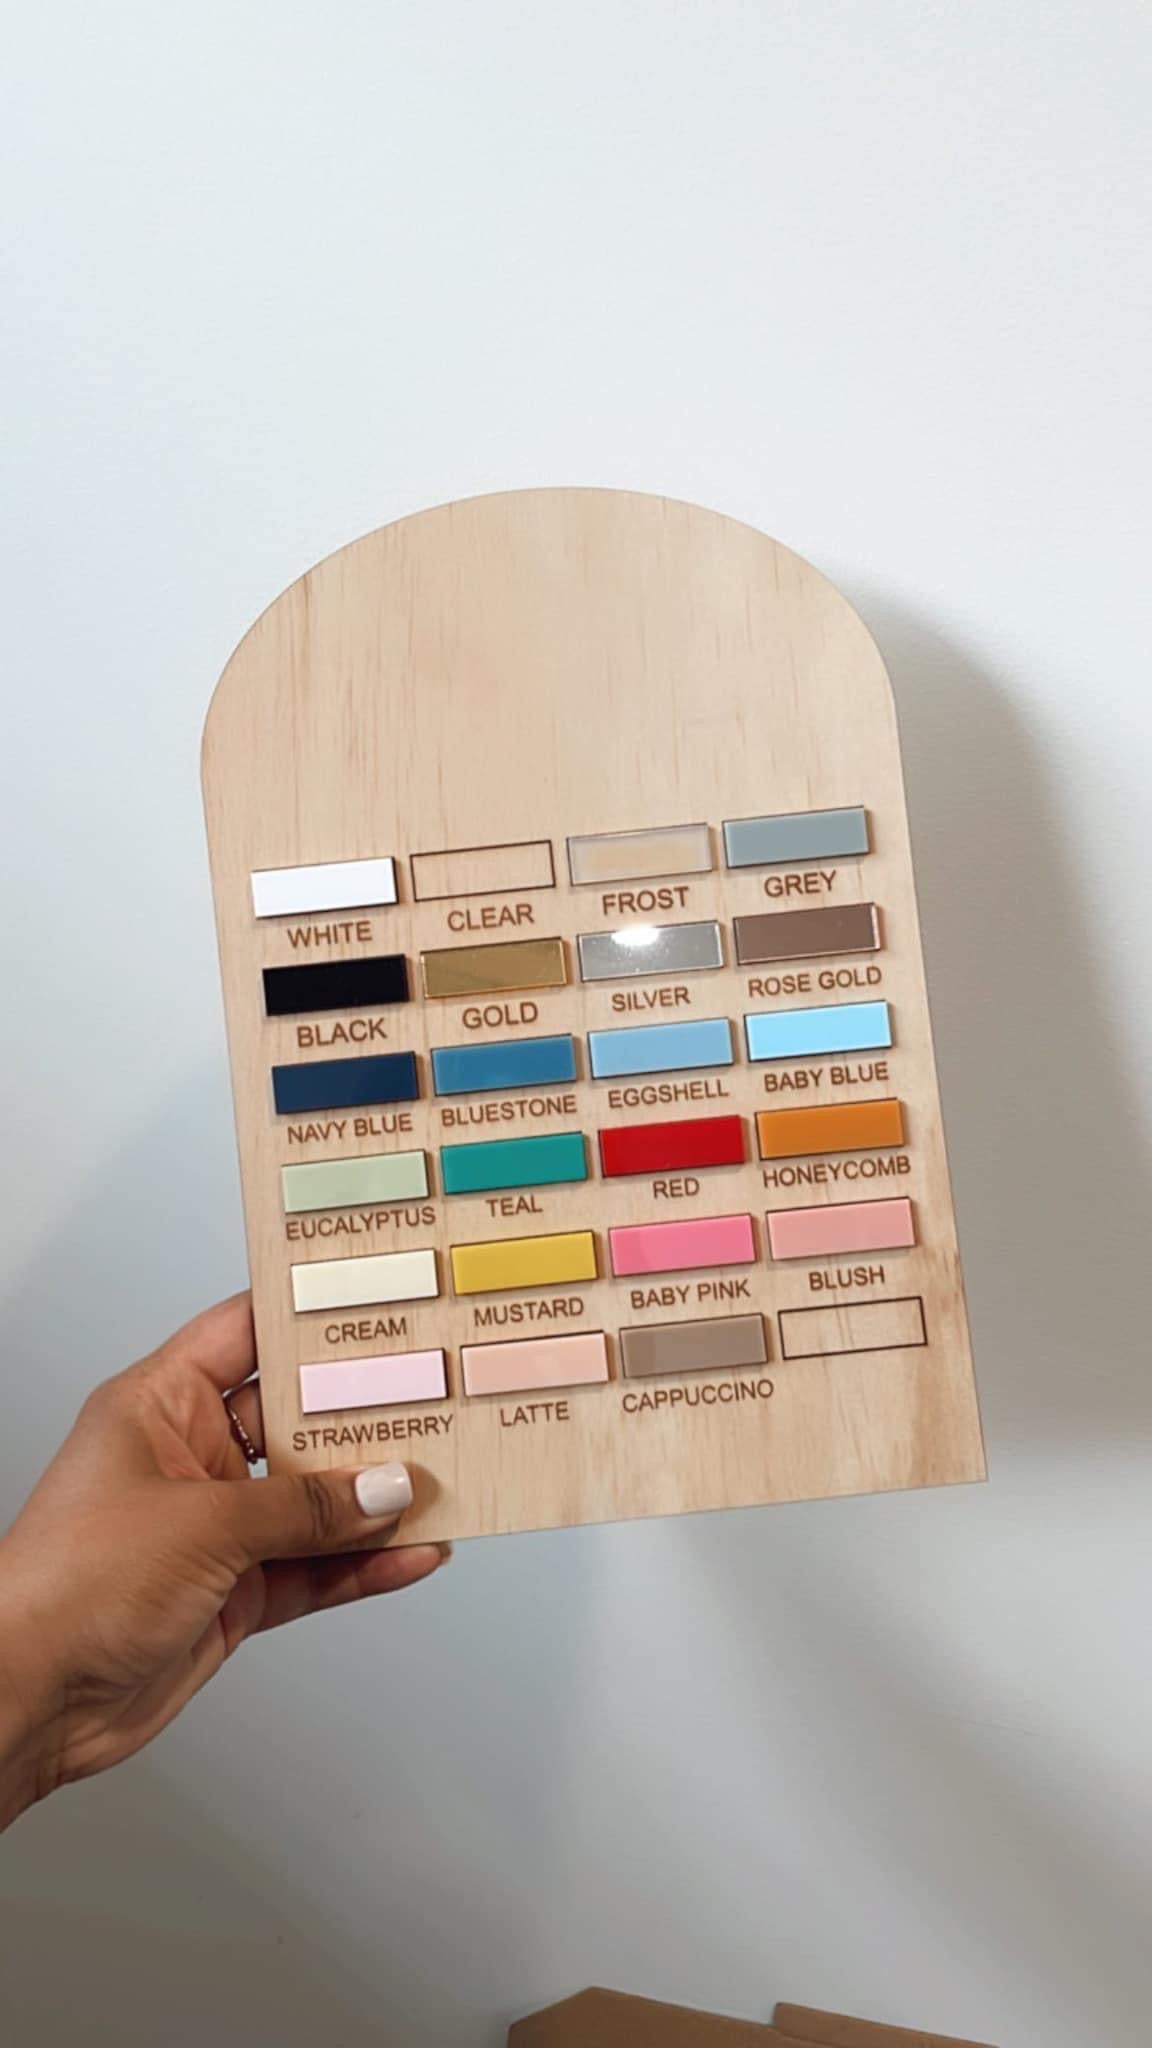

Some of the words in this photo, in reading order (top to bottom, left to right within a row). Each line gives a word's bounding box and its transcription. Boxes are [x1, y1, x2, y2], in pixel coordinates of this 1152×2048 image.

[764, 870, 837, 898] GREY
[602, 886, 689, 915] FROST
[447, 903, 535, 932] CLEAR
[287, 920, 373, 949] WHITE
[748, 974, 811, 997] ROSE
[818, 966, 882, 991] GOLD
[612, 987, 690, 1012] SILVER
[462, 1001, 538, 1030] GOLD
[297, 1018, 387, 1048] BLACK
[764, 1068, 824, 1092] BABY
[831, 1062, 889, 1085] BLUE
[608, 1080, 729, 1109] EGGSHELL
[441, 1095, 577, 1126] BLUESTONE
[288, 1119, 347, 1144] NAVY
[354, 1113, 413, 1136] BLUE
[763, 1155, 911, 1188] HONEYCOMB
[653, 1177, 699, 1200] RED
[486, 1196, 543, 1218] TEAL
[286, 1206, 436, 1240] EUCALYPTUS
[809, 1265, 885, 1291] BLUSH
[631, 1285, 691, 1310] BABY
[698, 1279, 750, 1301] PINK
[474, 1297, 584, 1327] MUSTARD
[325, 1317, 407, 1344] CREAM
[622, 1379, 774, 1413] CAPPUCCINO
[500, 1402, 570, 1427] LATTE
[293, 1414, 454, 1451] STRAWBERRY
